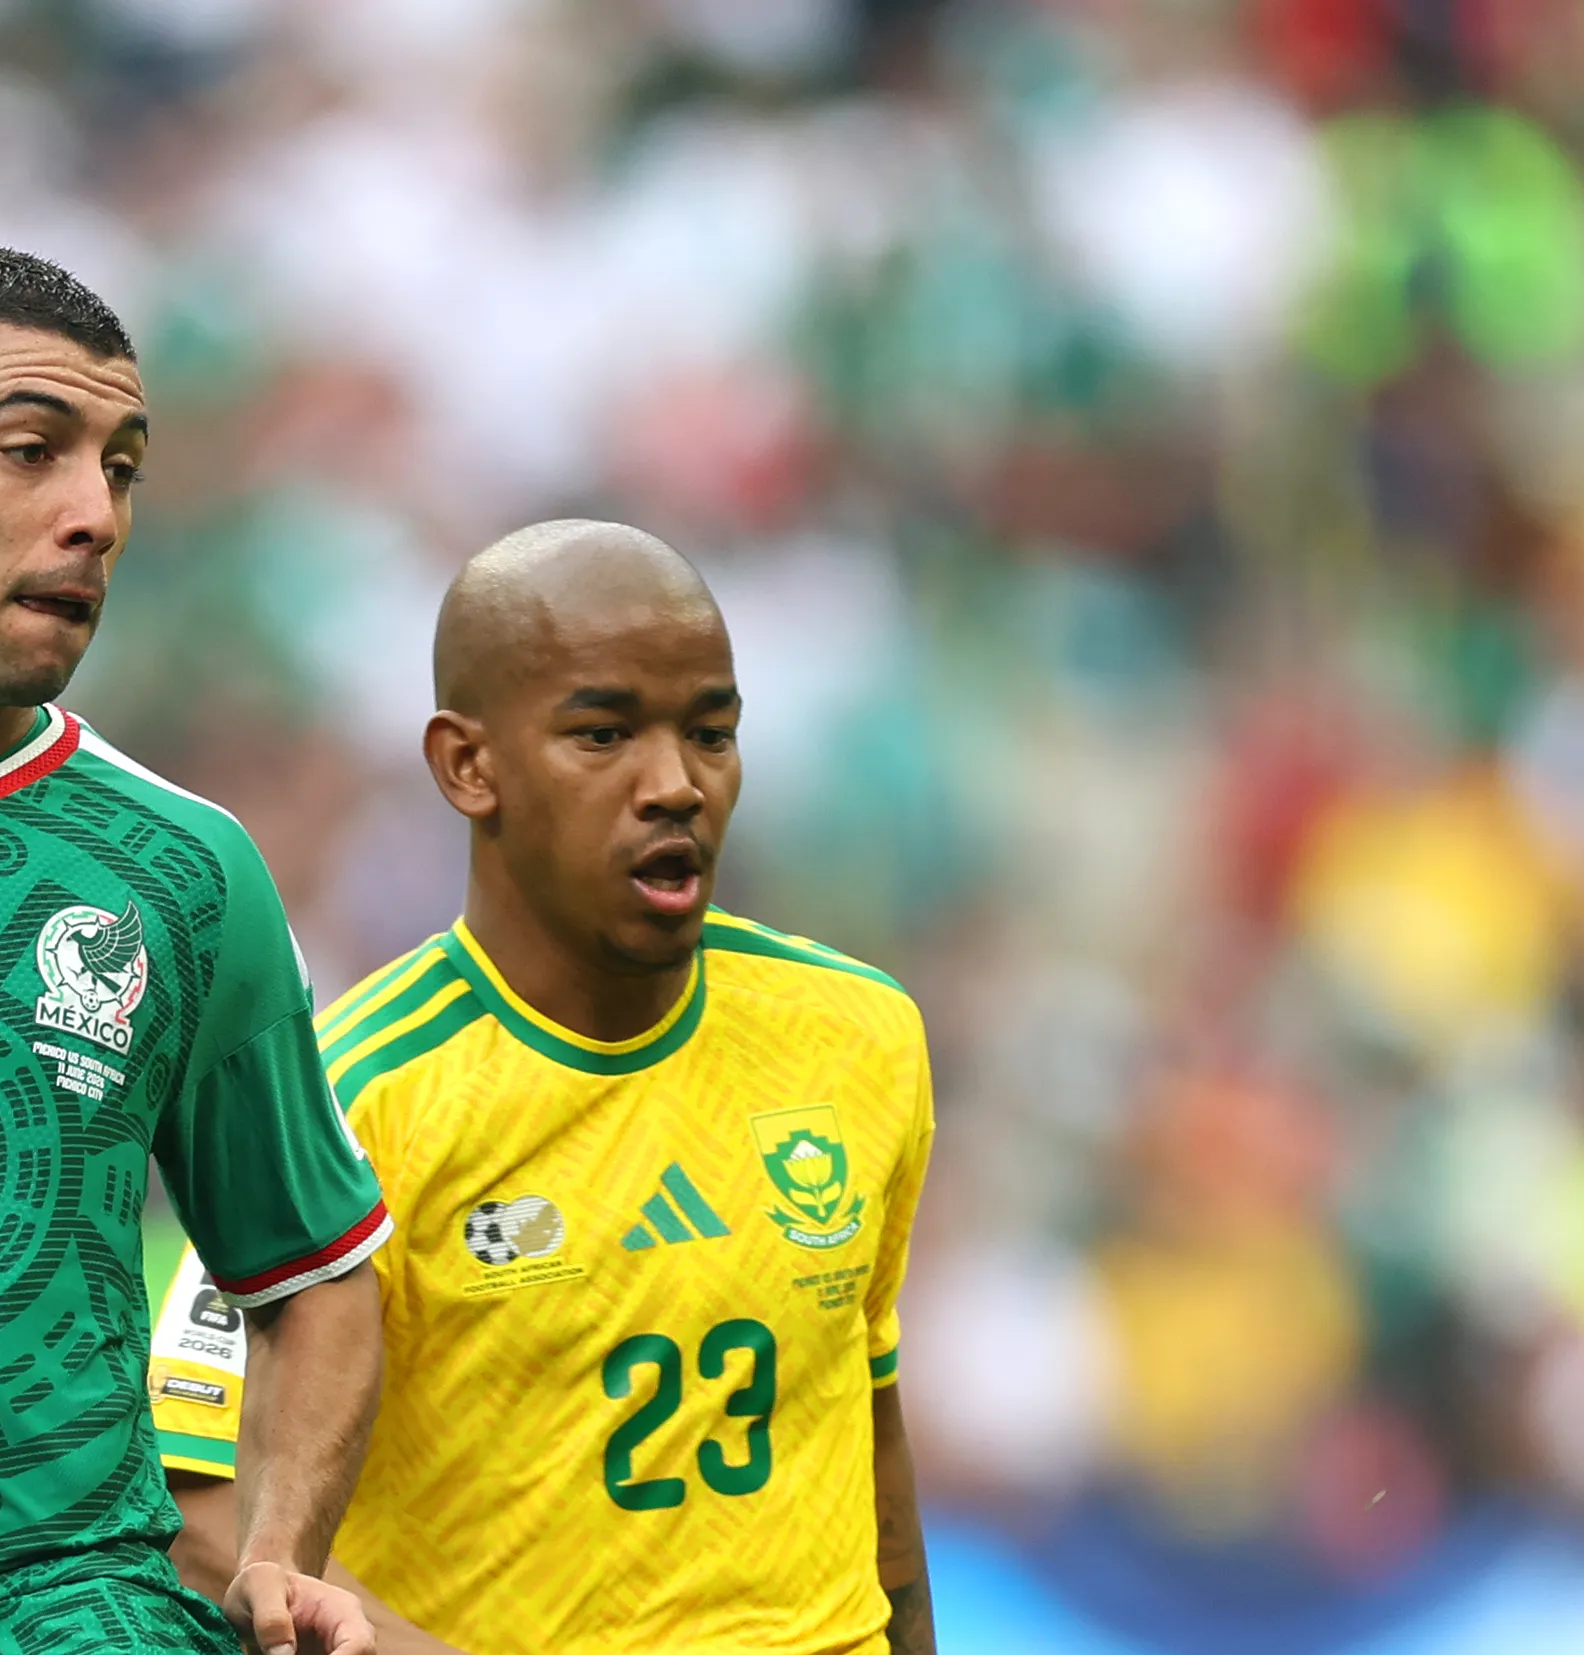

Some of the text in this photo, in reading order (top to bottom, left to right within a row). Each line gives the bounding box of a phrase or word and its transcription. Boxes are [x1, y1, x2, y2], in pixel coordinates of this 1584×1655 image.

[39, 1003, 129, 1048] MÉXICO
[32, 1041, 67, 1061] MEXICO
[56, 1075, 87, 1095] MEXICO
[177, 1338, 233, 1360] 2026
[167, 1379, 223, 1396] DEBUT
[602, 1318, 777, 1511] 23
